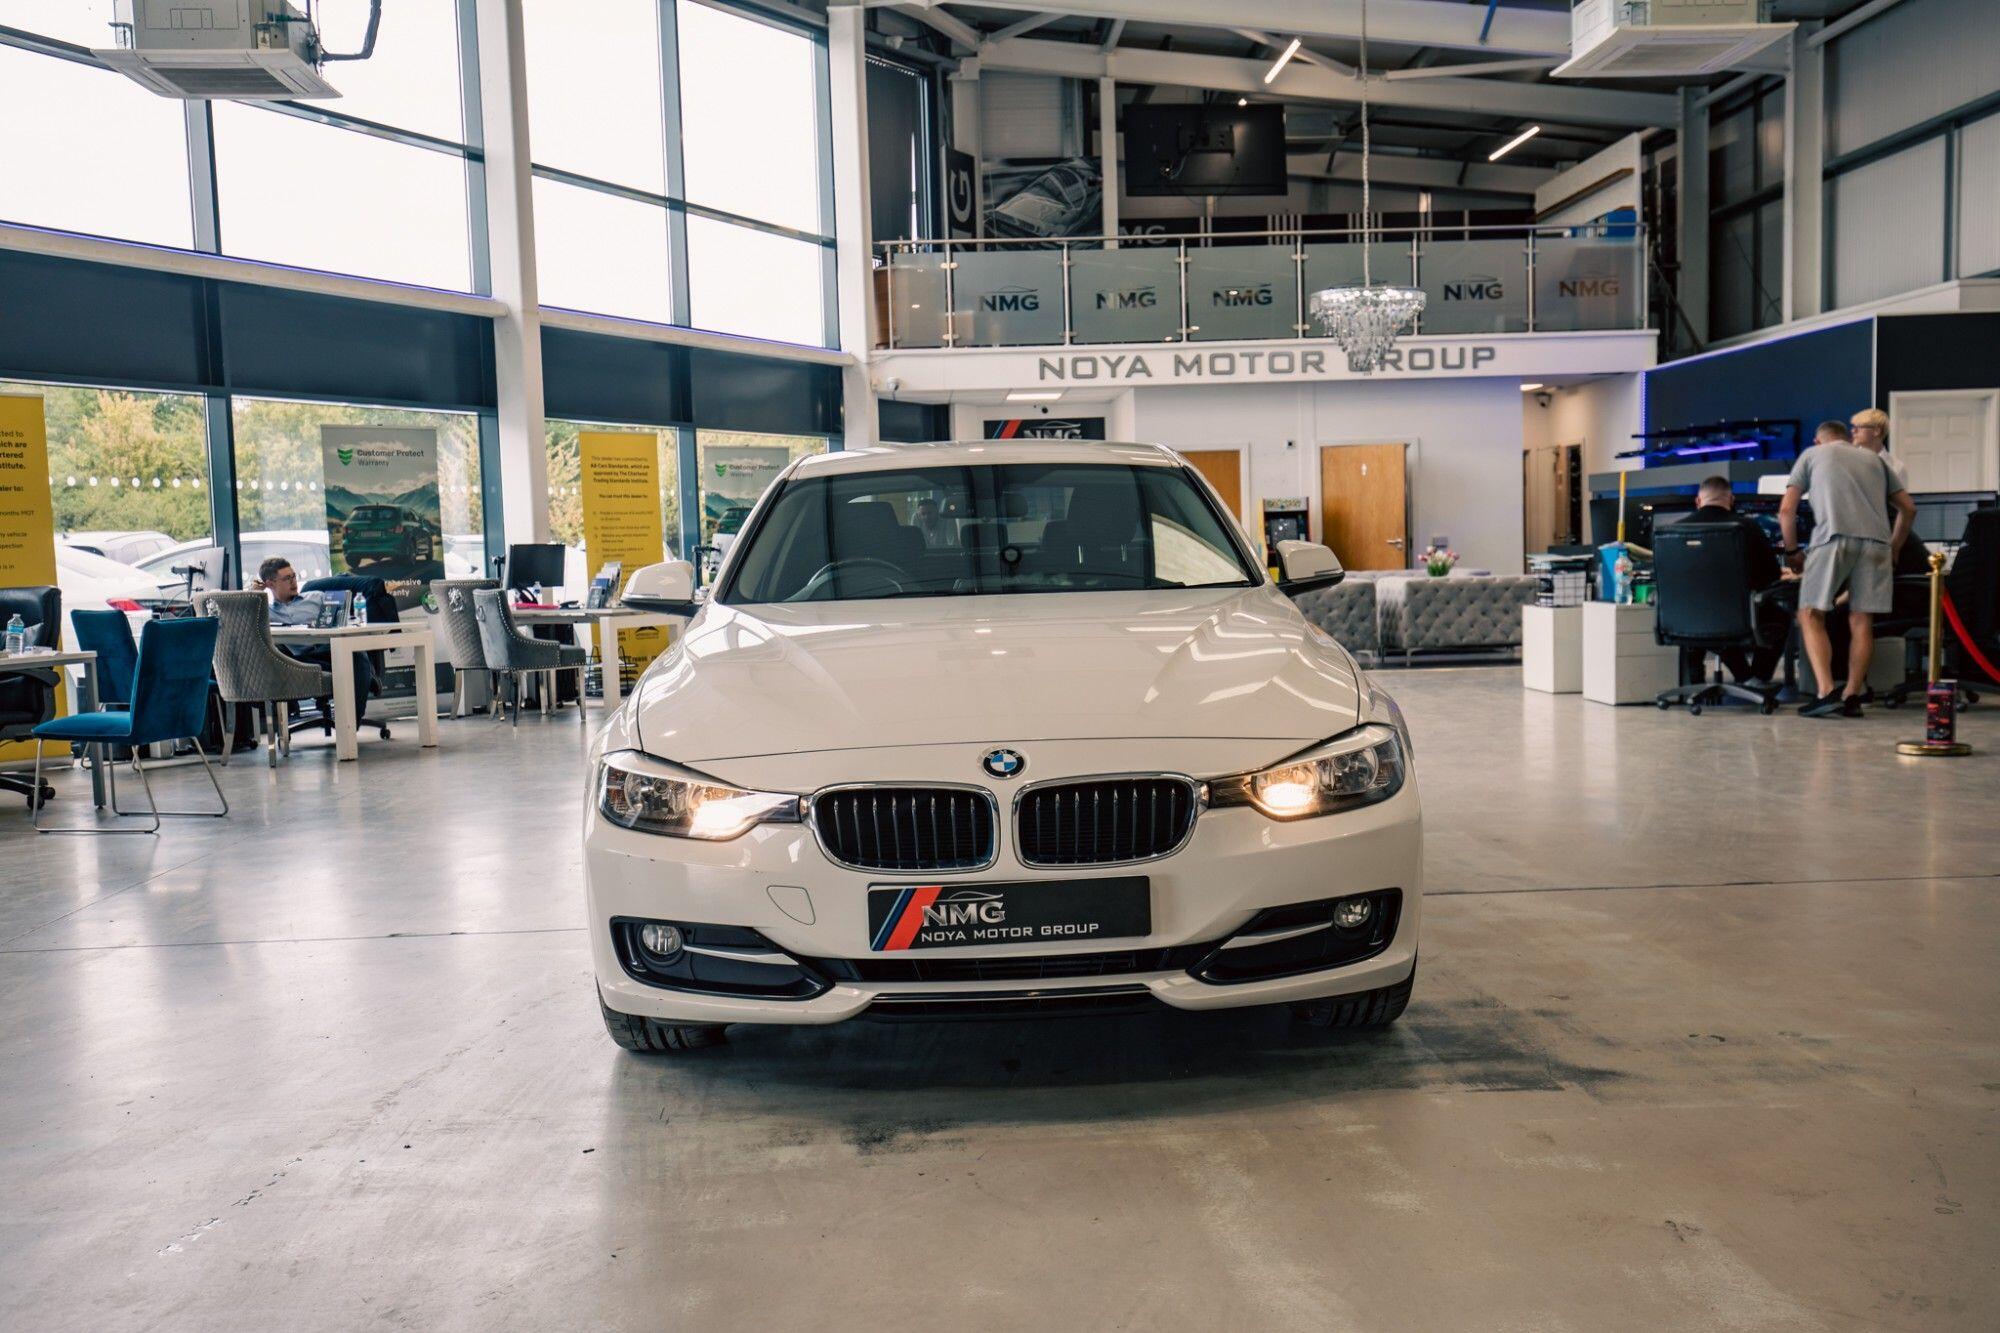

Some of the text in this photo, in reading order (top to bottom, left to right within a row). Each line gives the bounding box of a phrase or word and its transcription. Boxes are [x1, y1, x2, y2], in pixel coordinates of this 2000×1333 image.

[1119, 225, 1167, 245] MG
[1213, 289, 1272, 307] NMG
[1444, 282, 1504, 301] NMG
[1559, 279, 1619, 298] NMG
[980, 294, 1040, 312] NMG
[1096, 291, 1156, 310] NMG
[1039, 354, 1152, 380] NOYA
[1174, 350, 1325, 376] MOTOR
[357, 449, 424, 457] Customer Protect
[921, 900, 1006, 928] NMG
[921, 923, 1099, 942] NOYA MOTOR GROUP
